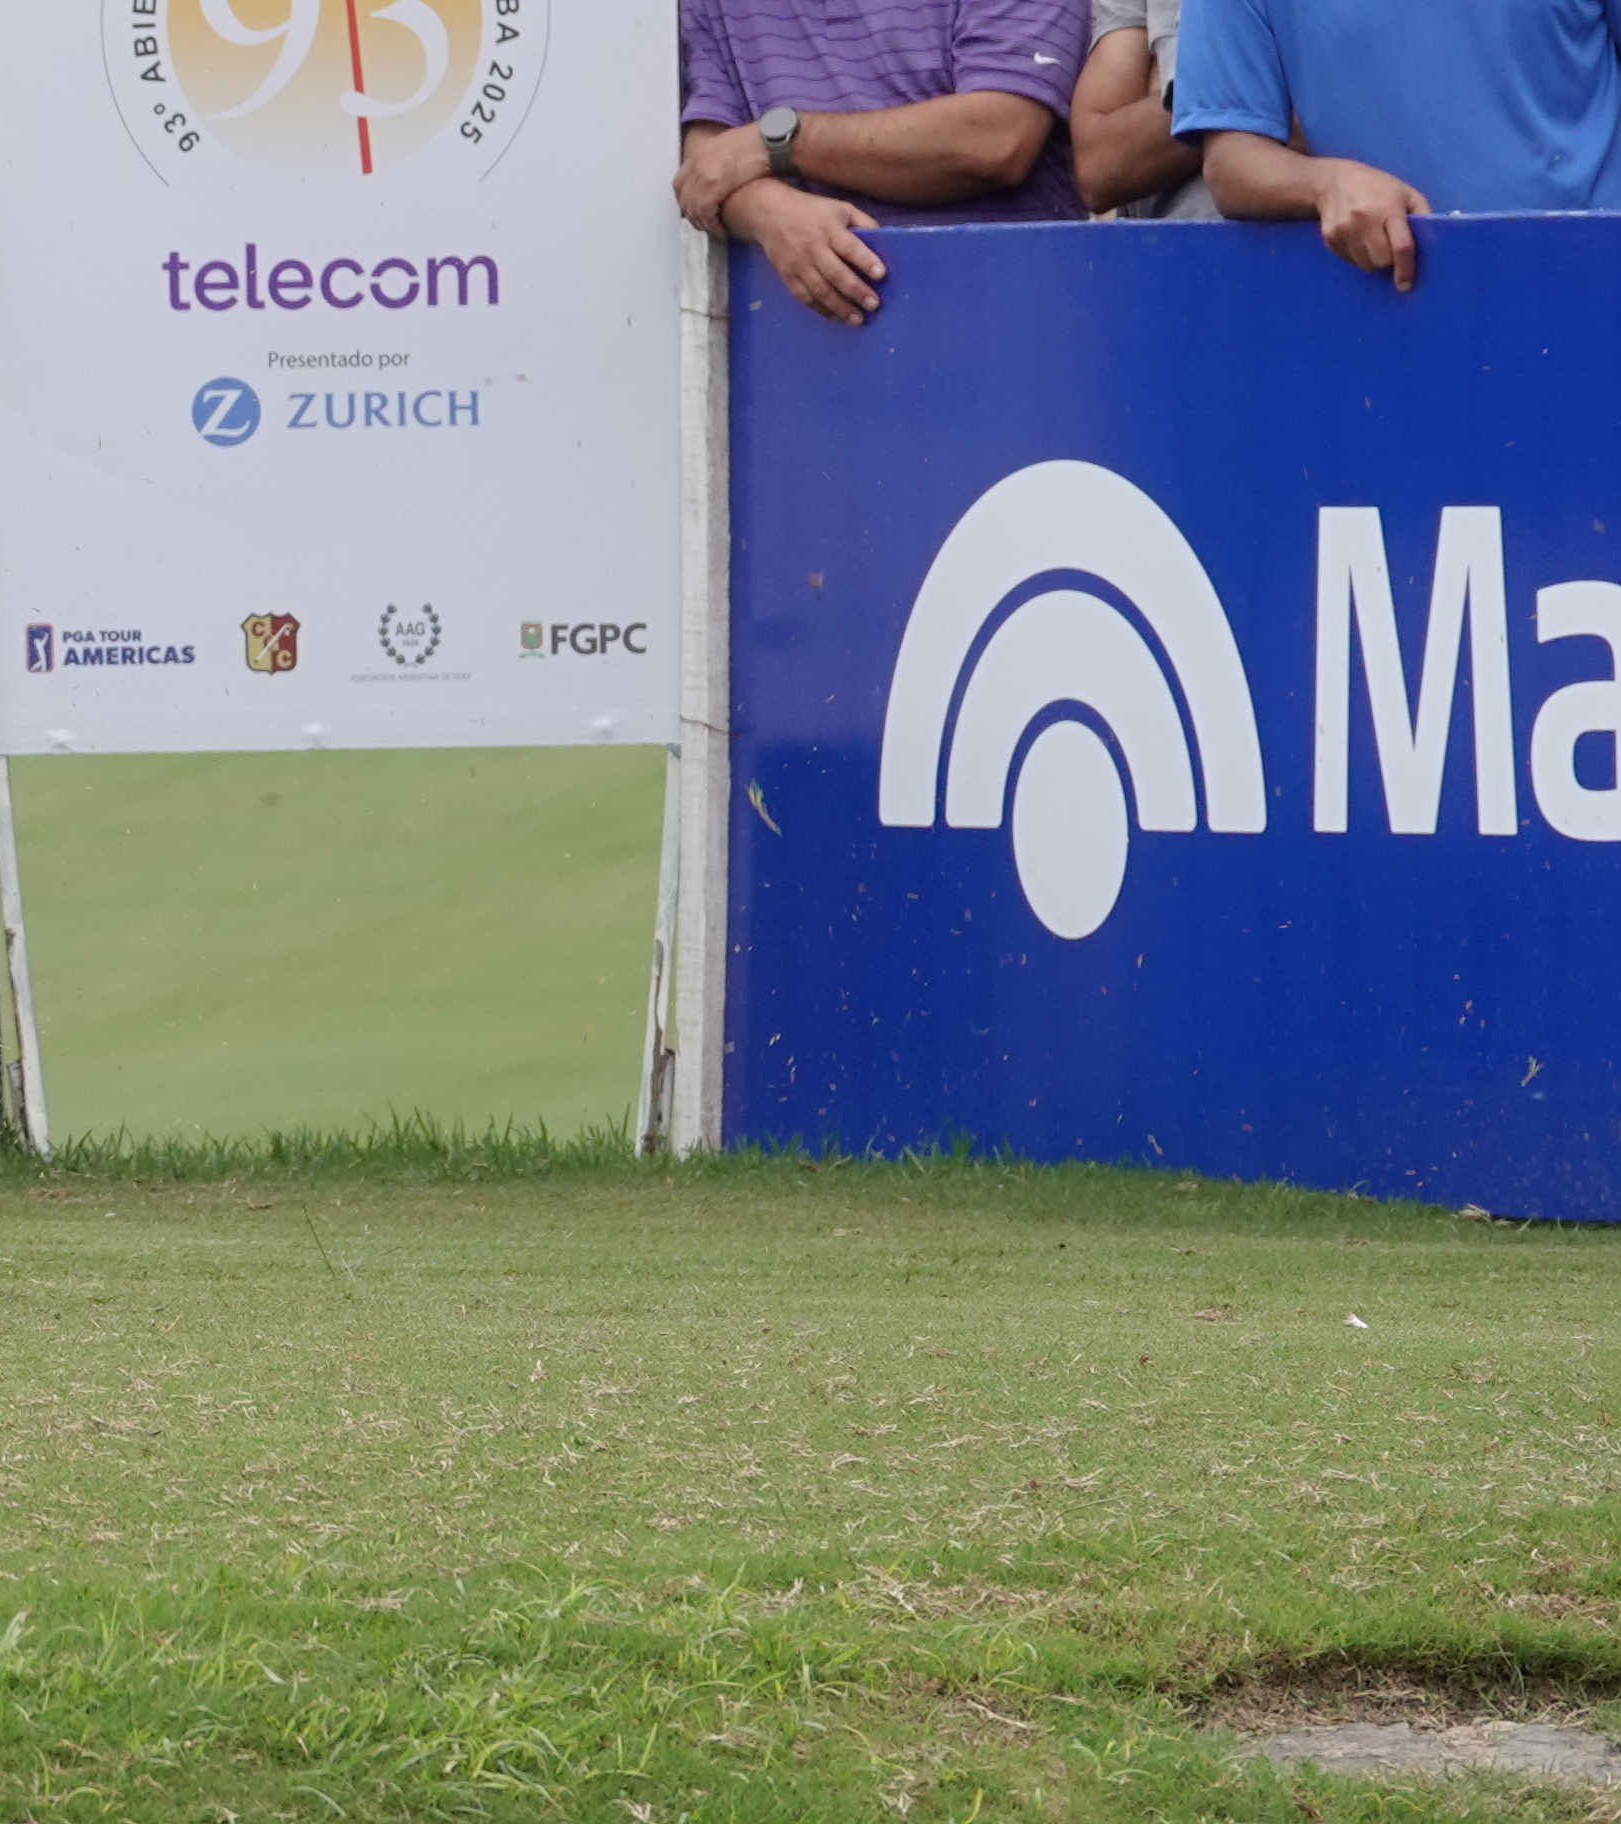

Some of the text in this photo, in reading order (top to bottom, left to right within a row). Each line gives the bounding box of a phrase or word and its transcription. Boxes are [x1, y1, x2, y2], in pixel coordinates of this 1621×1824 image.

[459, 60, 514, 145] 2025
[162, 243, 499, 311] telecom
[267, 350, 411, 371] Presentado por
[287, 389, 480, 429] ZURICH
[62, 629, 142, 643] PGA TOUR
[395, 621, 426, 636] AAG
[550, 622, 647, 655] FGPC
[63, 645, 196, 666] AMERICAS
